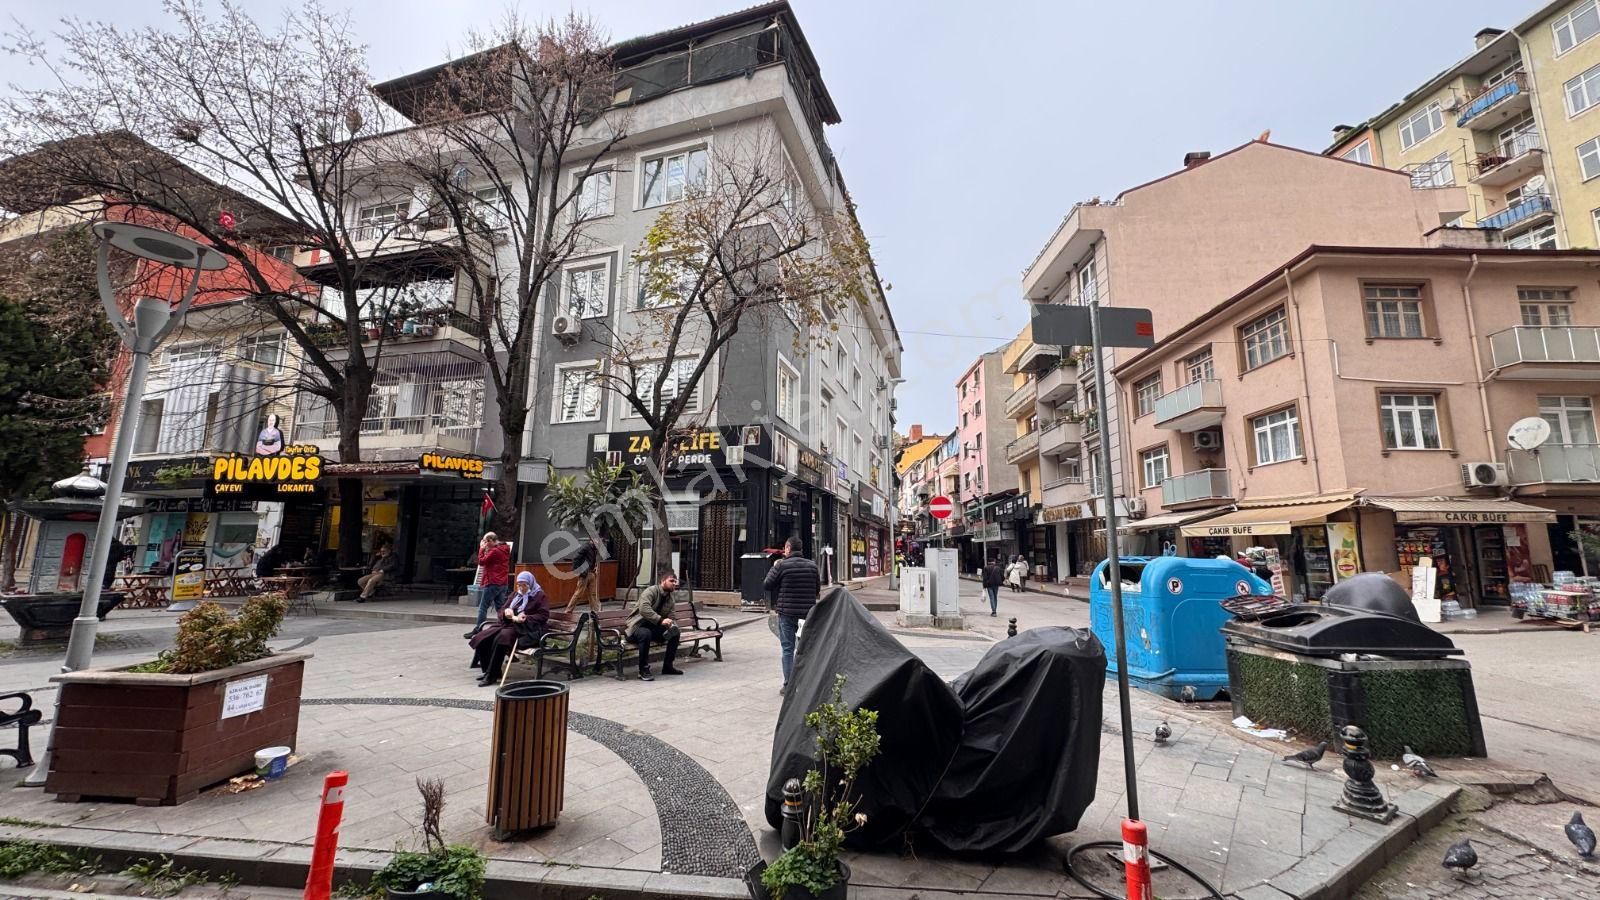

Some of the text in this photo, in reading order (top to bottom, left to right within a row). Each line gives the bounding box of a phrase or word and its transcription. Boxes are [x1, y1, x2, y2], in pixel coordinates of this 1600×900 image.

[423, 452, 483, 472] PİLAVDES
[678, 454, 712, 464] PERDE
[214, 453, 320, 480] PİLAVDES
[277, 483, 315, 492] LOKANTA
[1208, 527, 1230, 536] ÇAKIR
